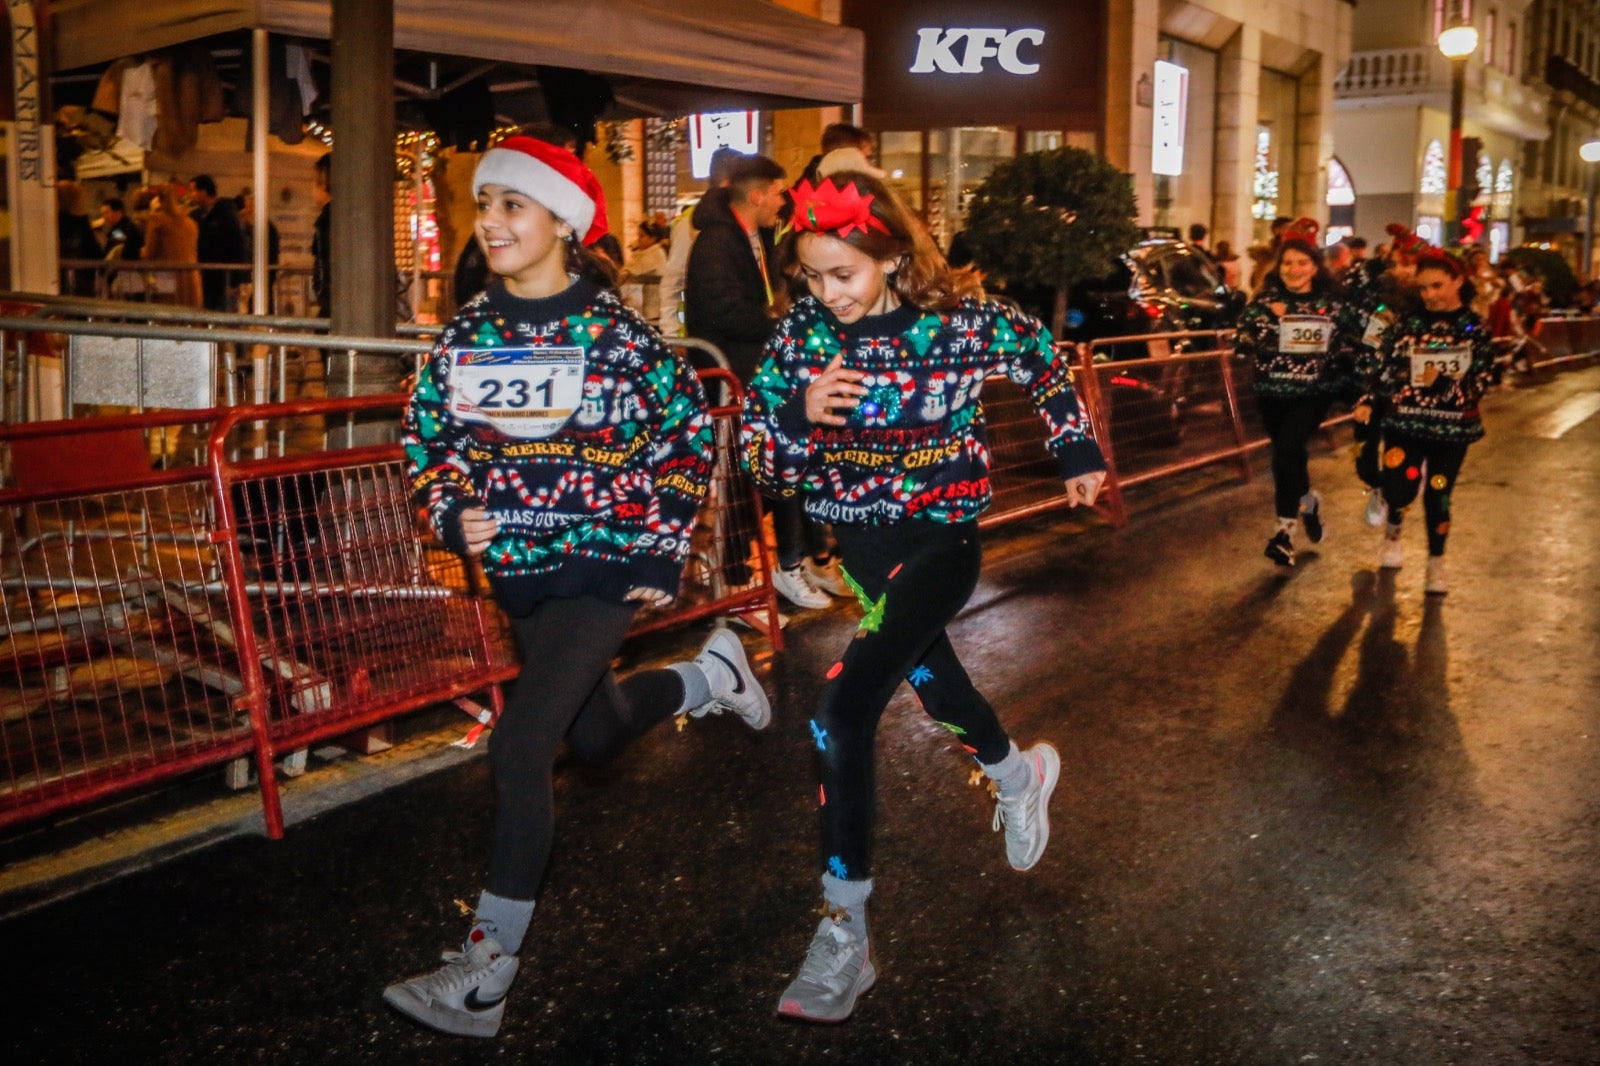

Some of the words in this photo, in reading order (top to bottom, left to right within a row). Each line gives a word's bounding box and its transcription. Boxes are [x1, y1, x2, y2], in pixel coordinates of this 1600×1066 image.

[909, 28, 1045, 75] KFC
[1292, 328, 1323, 340] 306
[478, 379, 554, 408] 231
[502, 442, 576, 457] MERRY
[824, 450, 899, 467] MERRY
